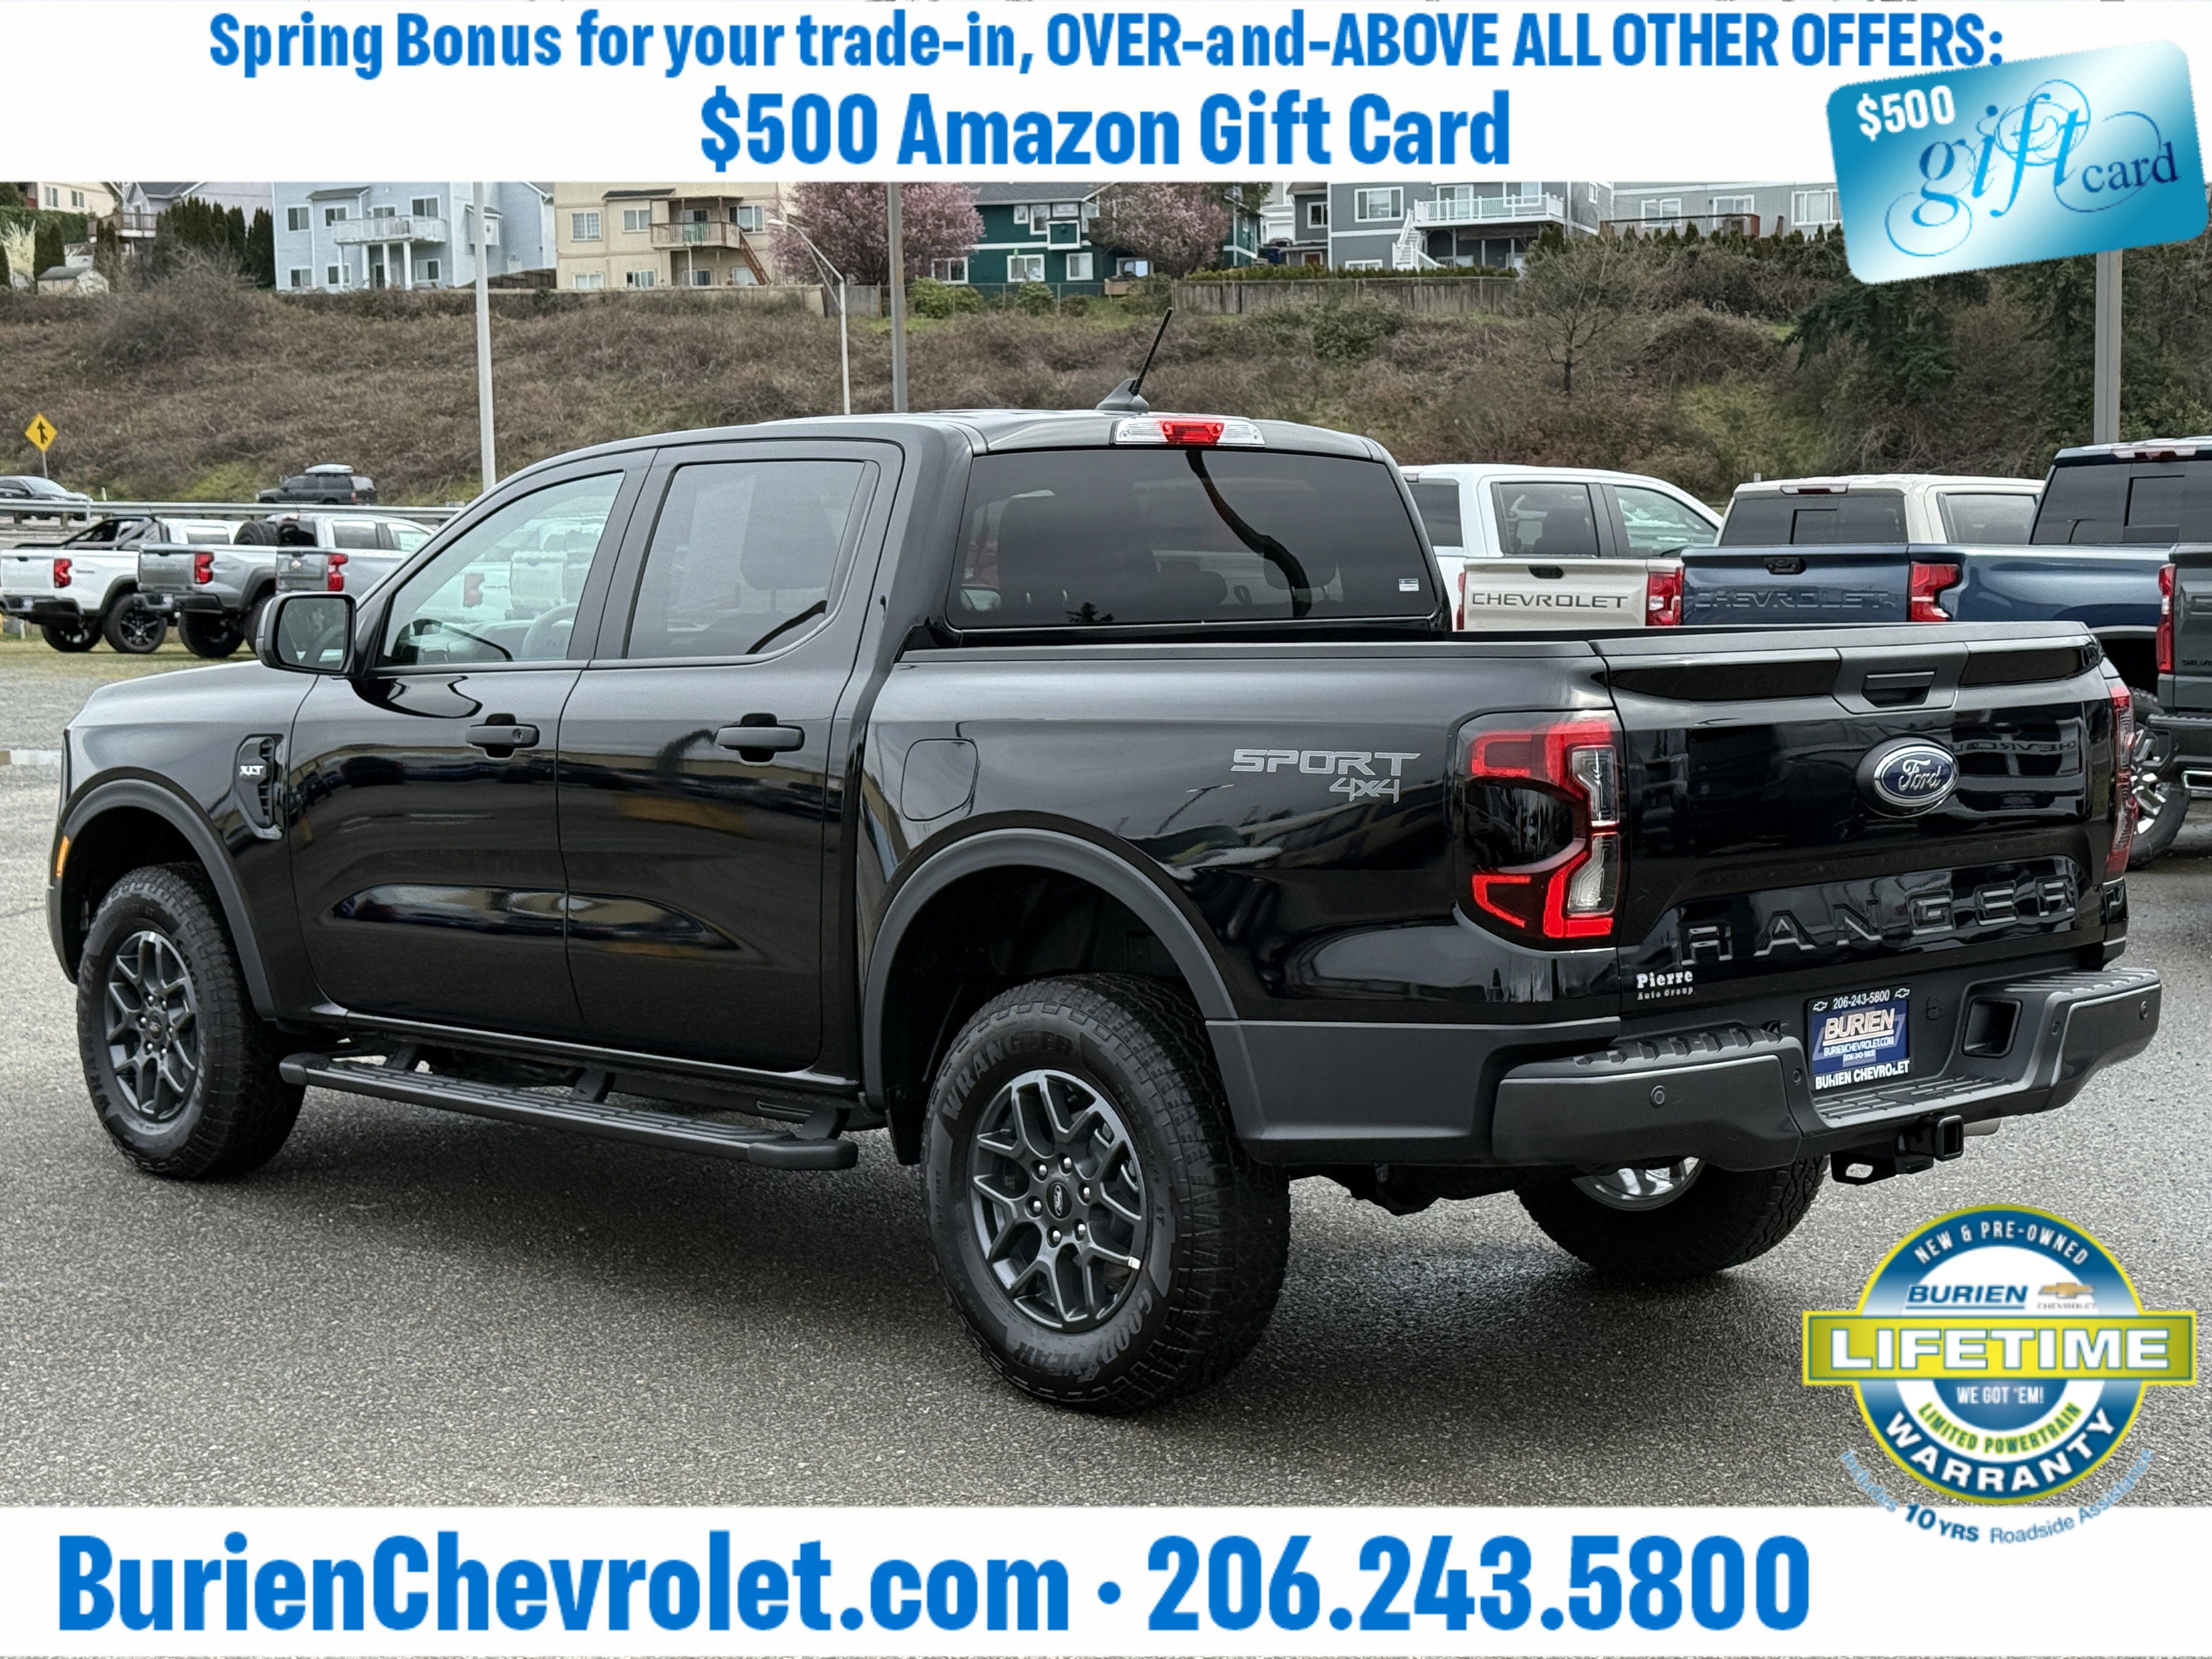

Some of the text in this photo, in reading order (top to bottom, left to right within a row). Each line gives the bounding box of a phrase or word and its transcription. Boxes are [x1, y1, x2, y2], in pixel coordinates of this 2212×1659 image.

[1472, 592, 1628, 609] CHEVROLET
[1695, 590, 1888, 609] CHEVROLET
[240, 765, 264, 776] XLT
[1230, 749, 1421, 776] SPORT
[1898, 759, 1942, 792] Ford
[1329, 777, 1400, 803] 4x4
[1679, 876, 2079, 966] RANGER
[1637, 970, 1693, 989] Pierre
[1637, 986, 1694, 1000] Auto Group
[1832, 989, 1891, 1010] 206-243-5800
[1825, 1008, 1895, 1040] BURIEN
[942, 1029, 1075, 1120] WRANGLER
[1815, 1070, 1852, 1090] BURIEN
